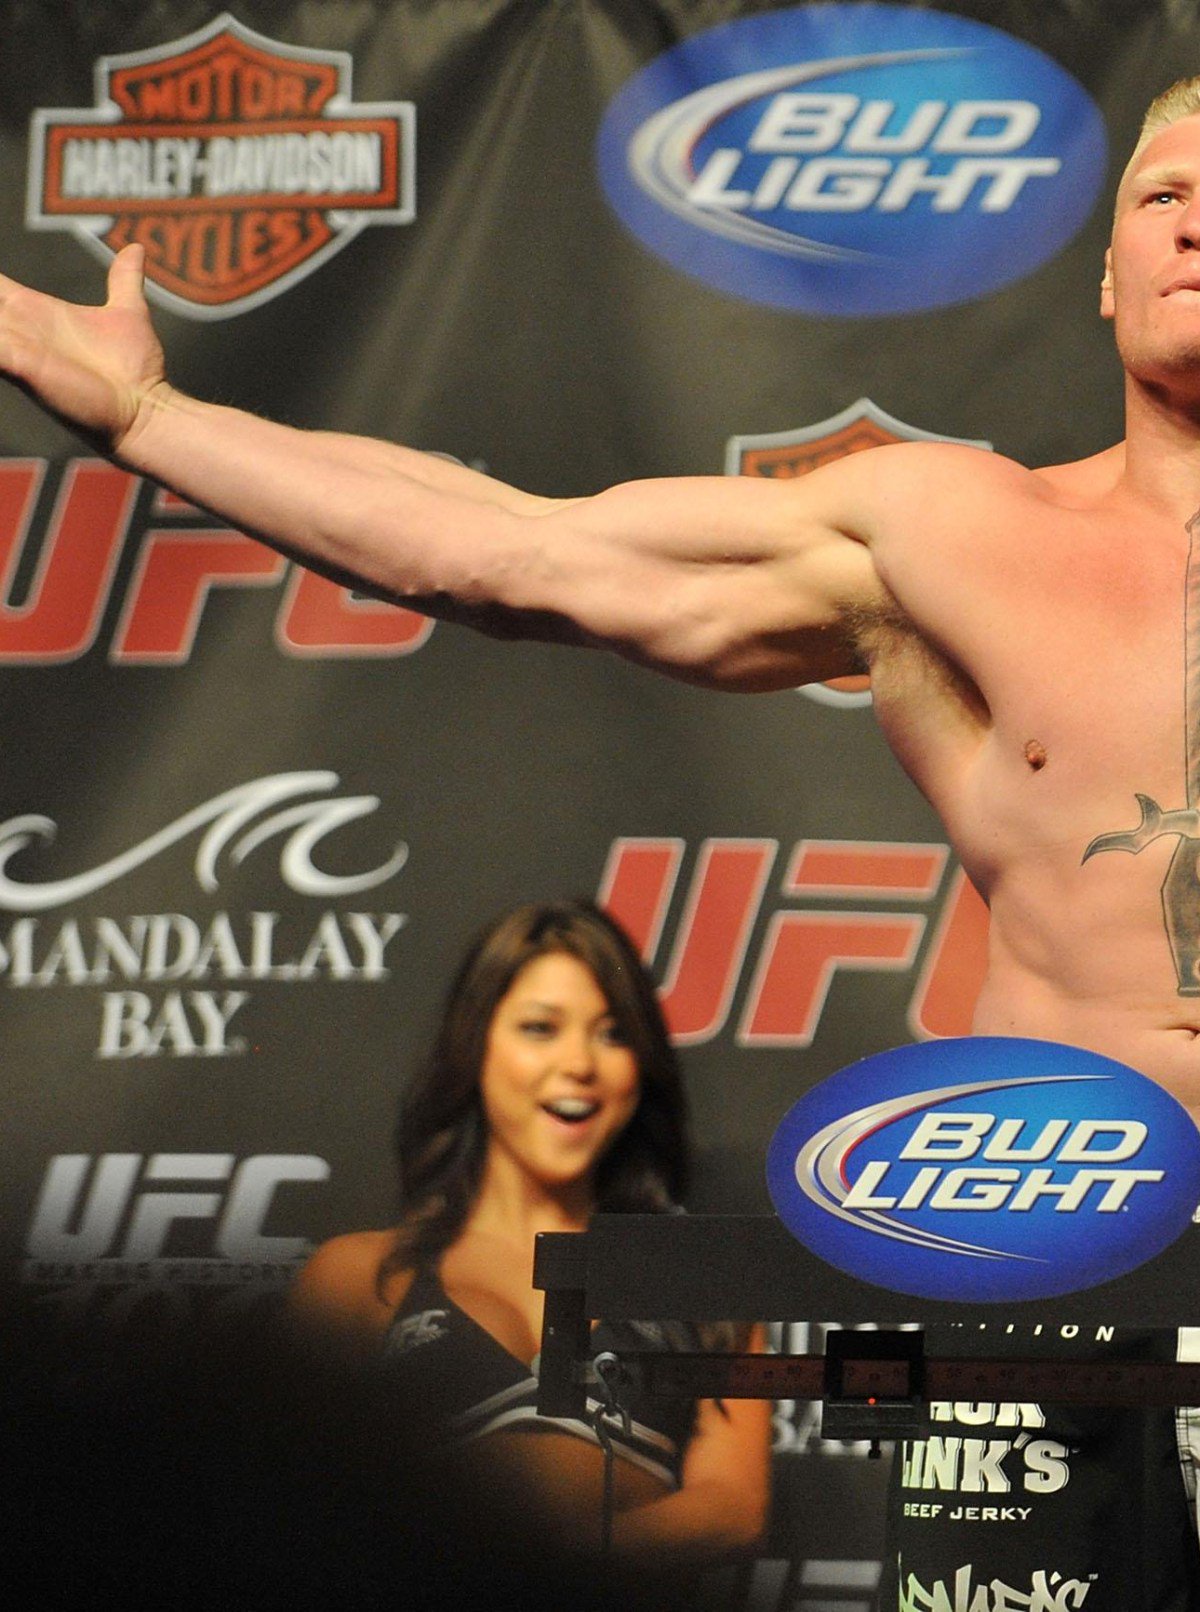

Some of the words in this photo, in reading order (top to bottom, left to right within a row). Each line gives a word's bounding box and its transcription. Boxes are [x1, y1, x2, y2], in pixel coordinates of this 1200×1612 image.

[143, 54, 306, 120] MOTOR
[749, 91, 1042, 155] BUD
[63, 131, 382, 198] HARLEY-DAVIDSON
[687, 148, 1062, 214] LIGHT
[140, 210, 304, 283] CYCLES
[96, 989, 250, 1060] BAY
[899, 1111, 1149, 1164] BUD
[24, 1152, 332, 1259] UFC
[841, 1160, 1166, 1213] LIGHT
[903, 1502, 944, 1520] BEEF
[949, 1505, 1033, 1522] JERKY
